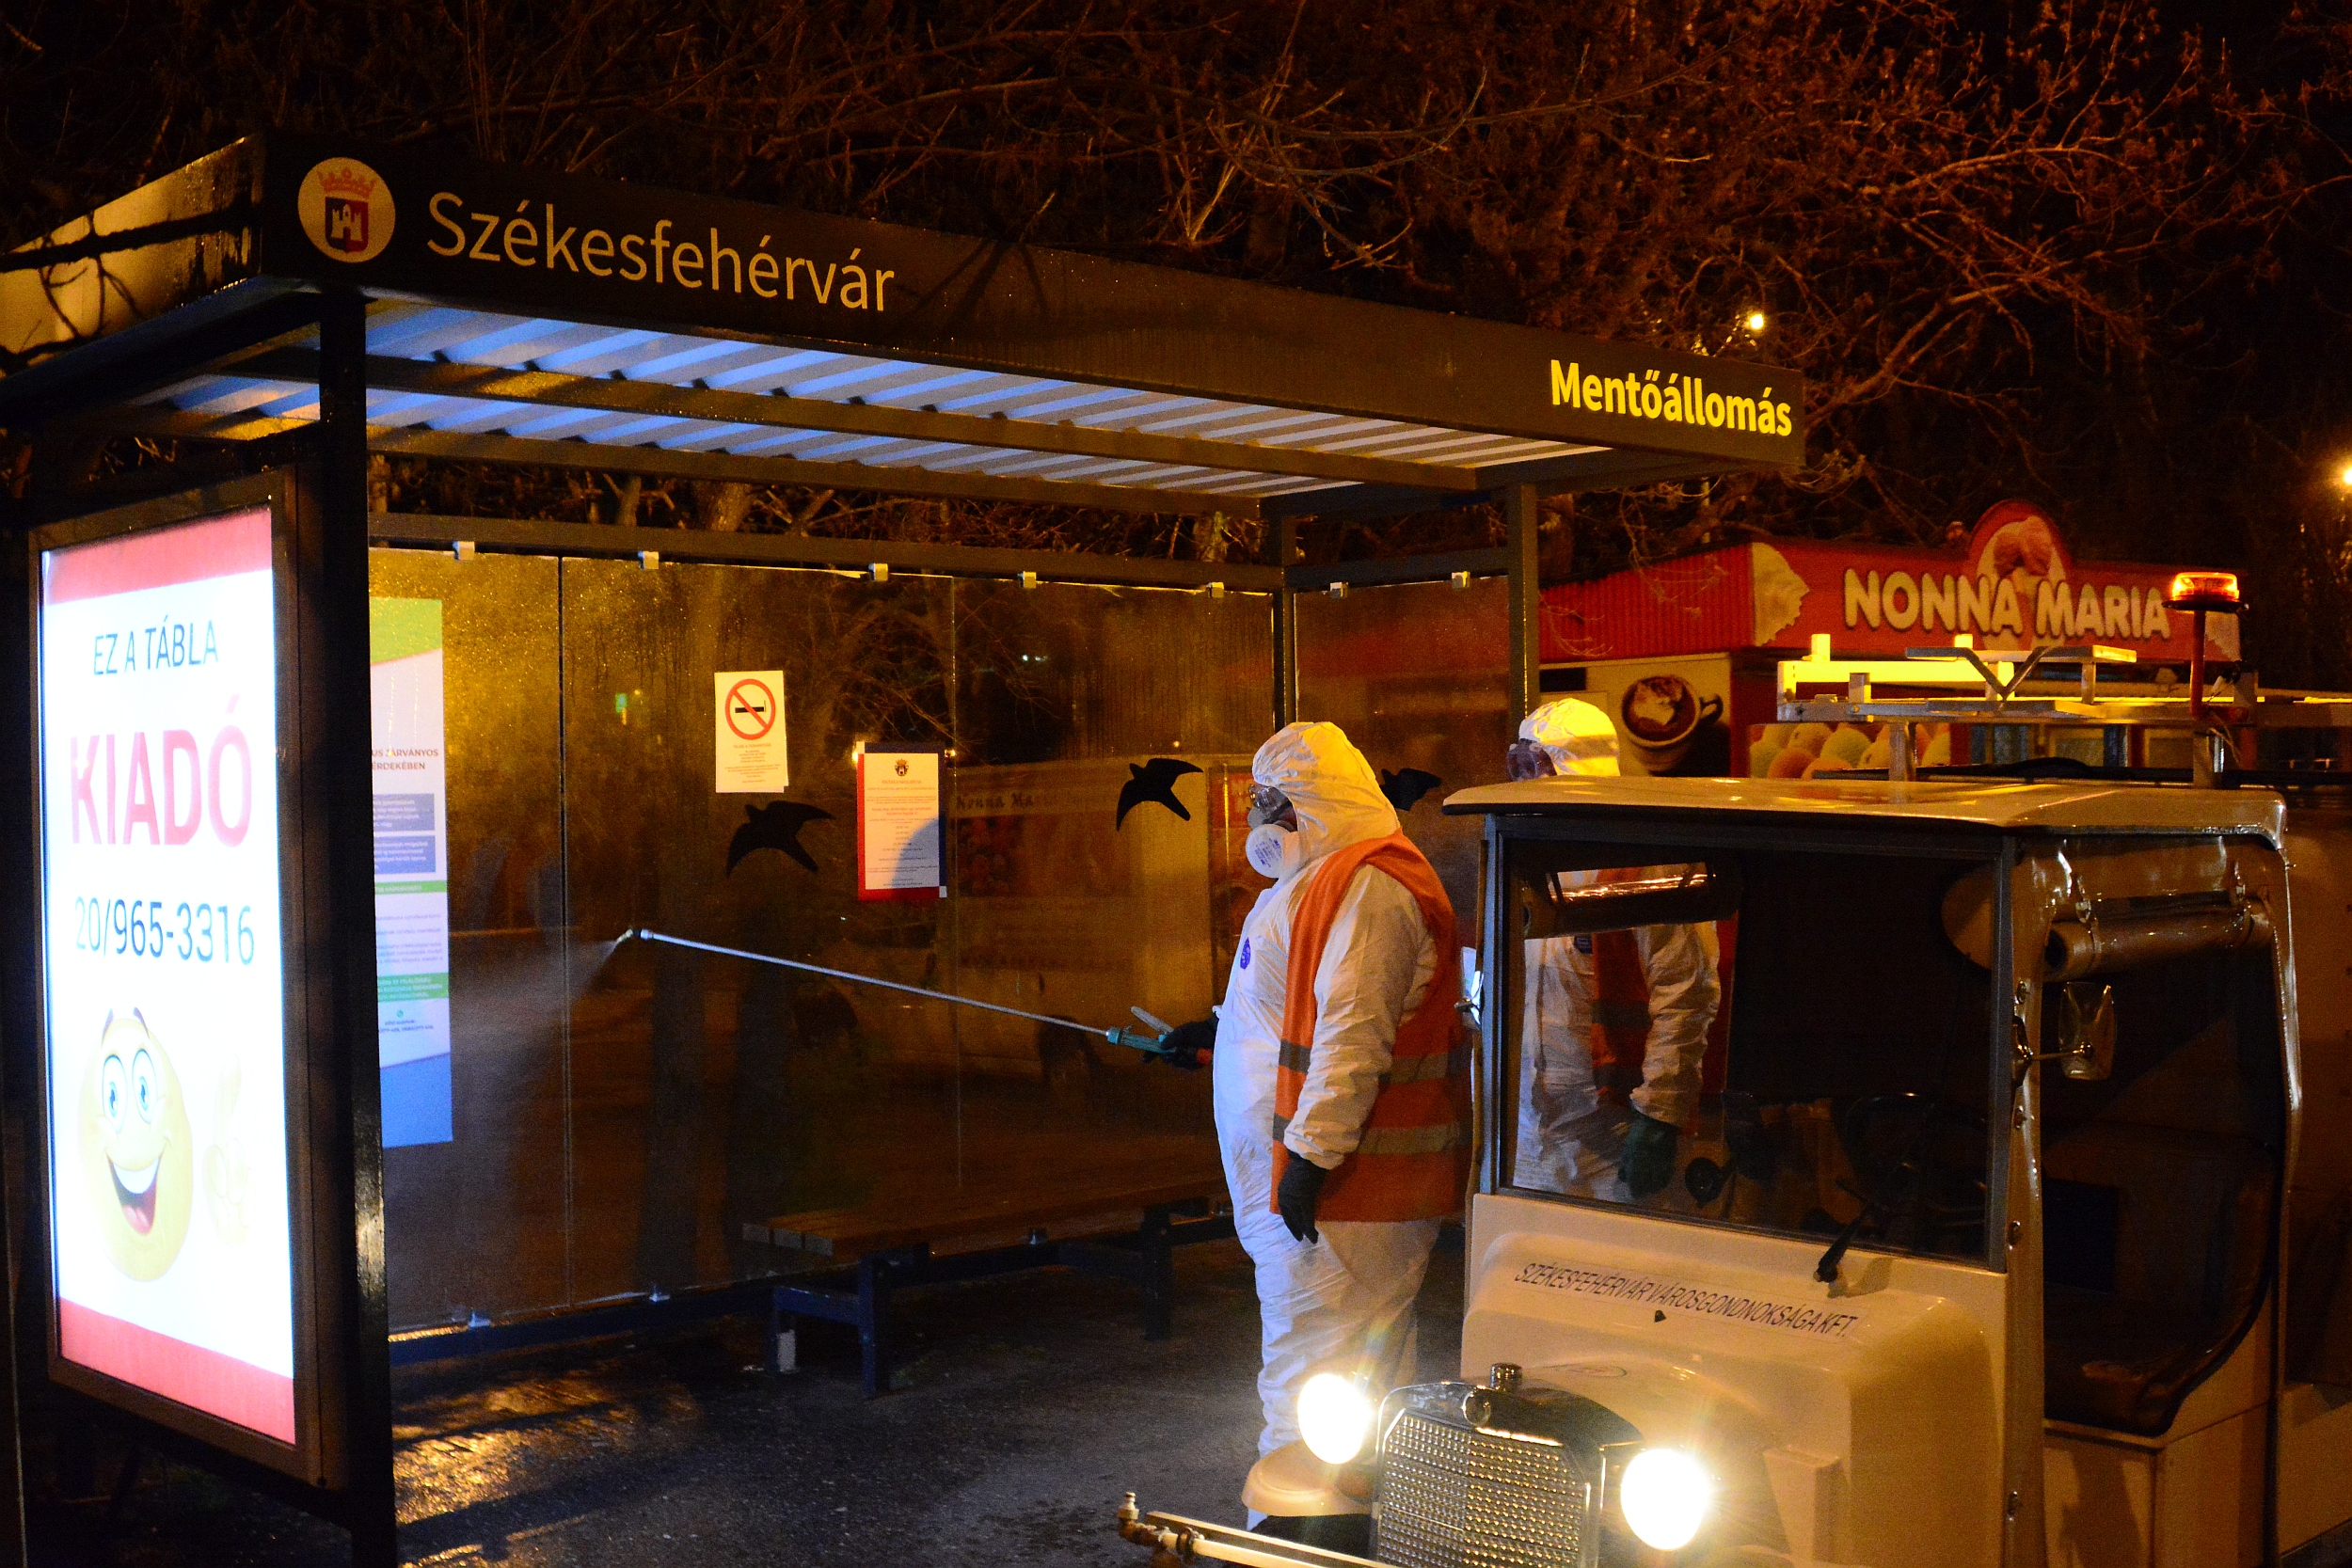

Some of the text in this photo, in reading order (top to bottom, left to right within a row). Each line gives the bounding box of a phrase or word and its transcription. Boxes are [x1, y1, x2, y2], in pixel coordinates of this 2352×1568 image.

[426, 191, 894, 311] Székesfehérvár
[1550, 359, 1792, 436] Mentőállomás
[1844, 568, 2170, 640] NONNA MARIA
[94, 614, 218, 675] EZ A TÁBLA
[71, 693, 252, 848] KIADÓ
[75, 896, 254, 966] 20/965-3316
[1515, 1262, 1858, 1338] SZÉKESFEHÉRVÁR VÁROSGONDNOKSÁGA KFT.
